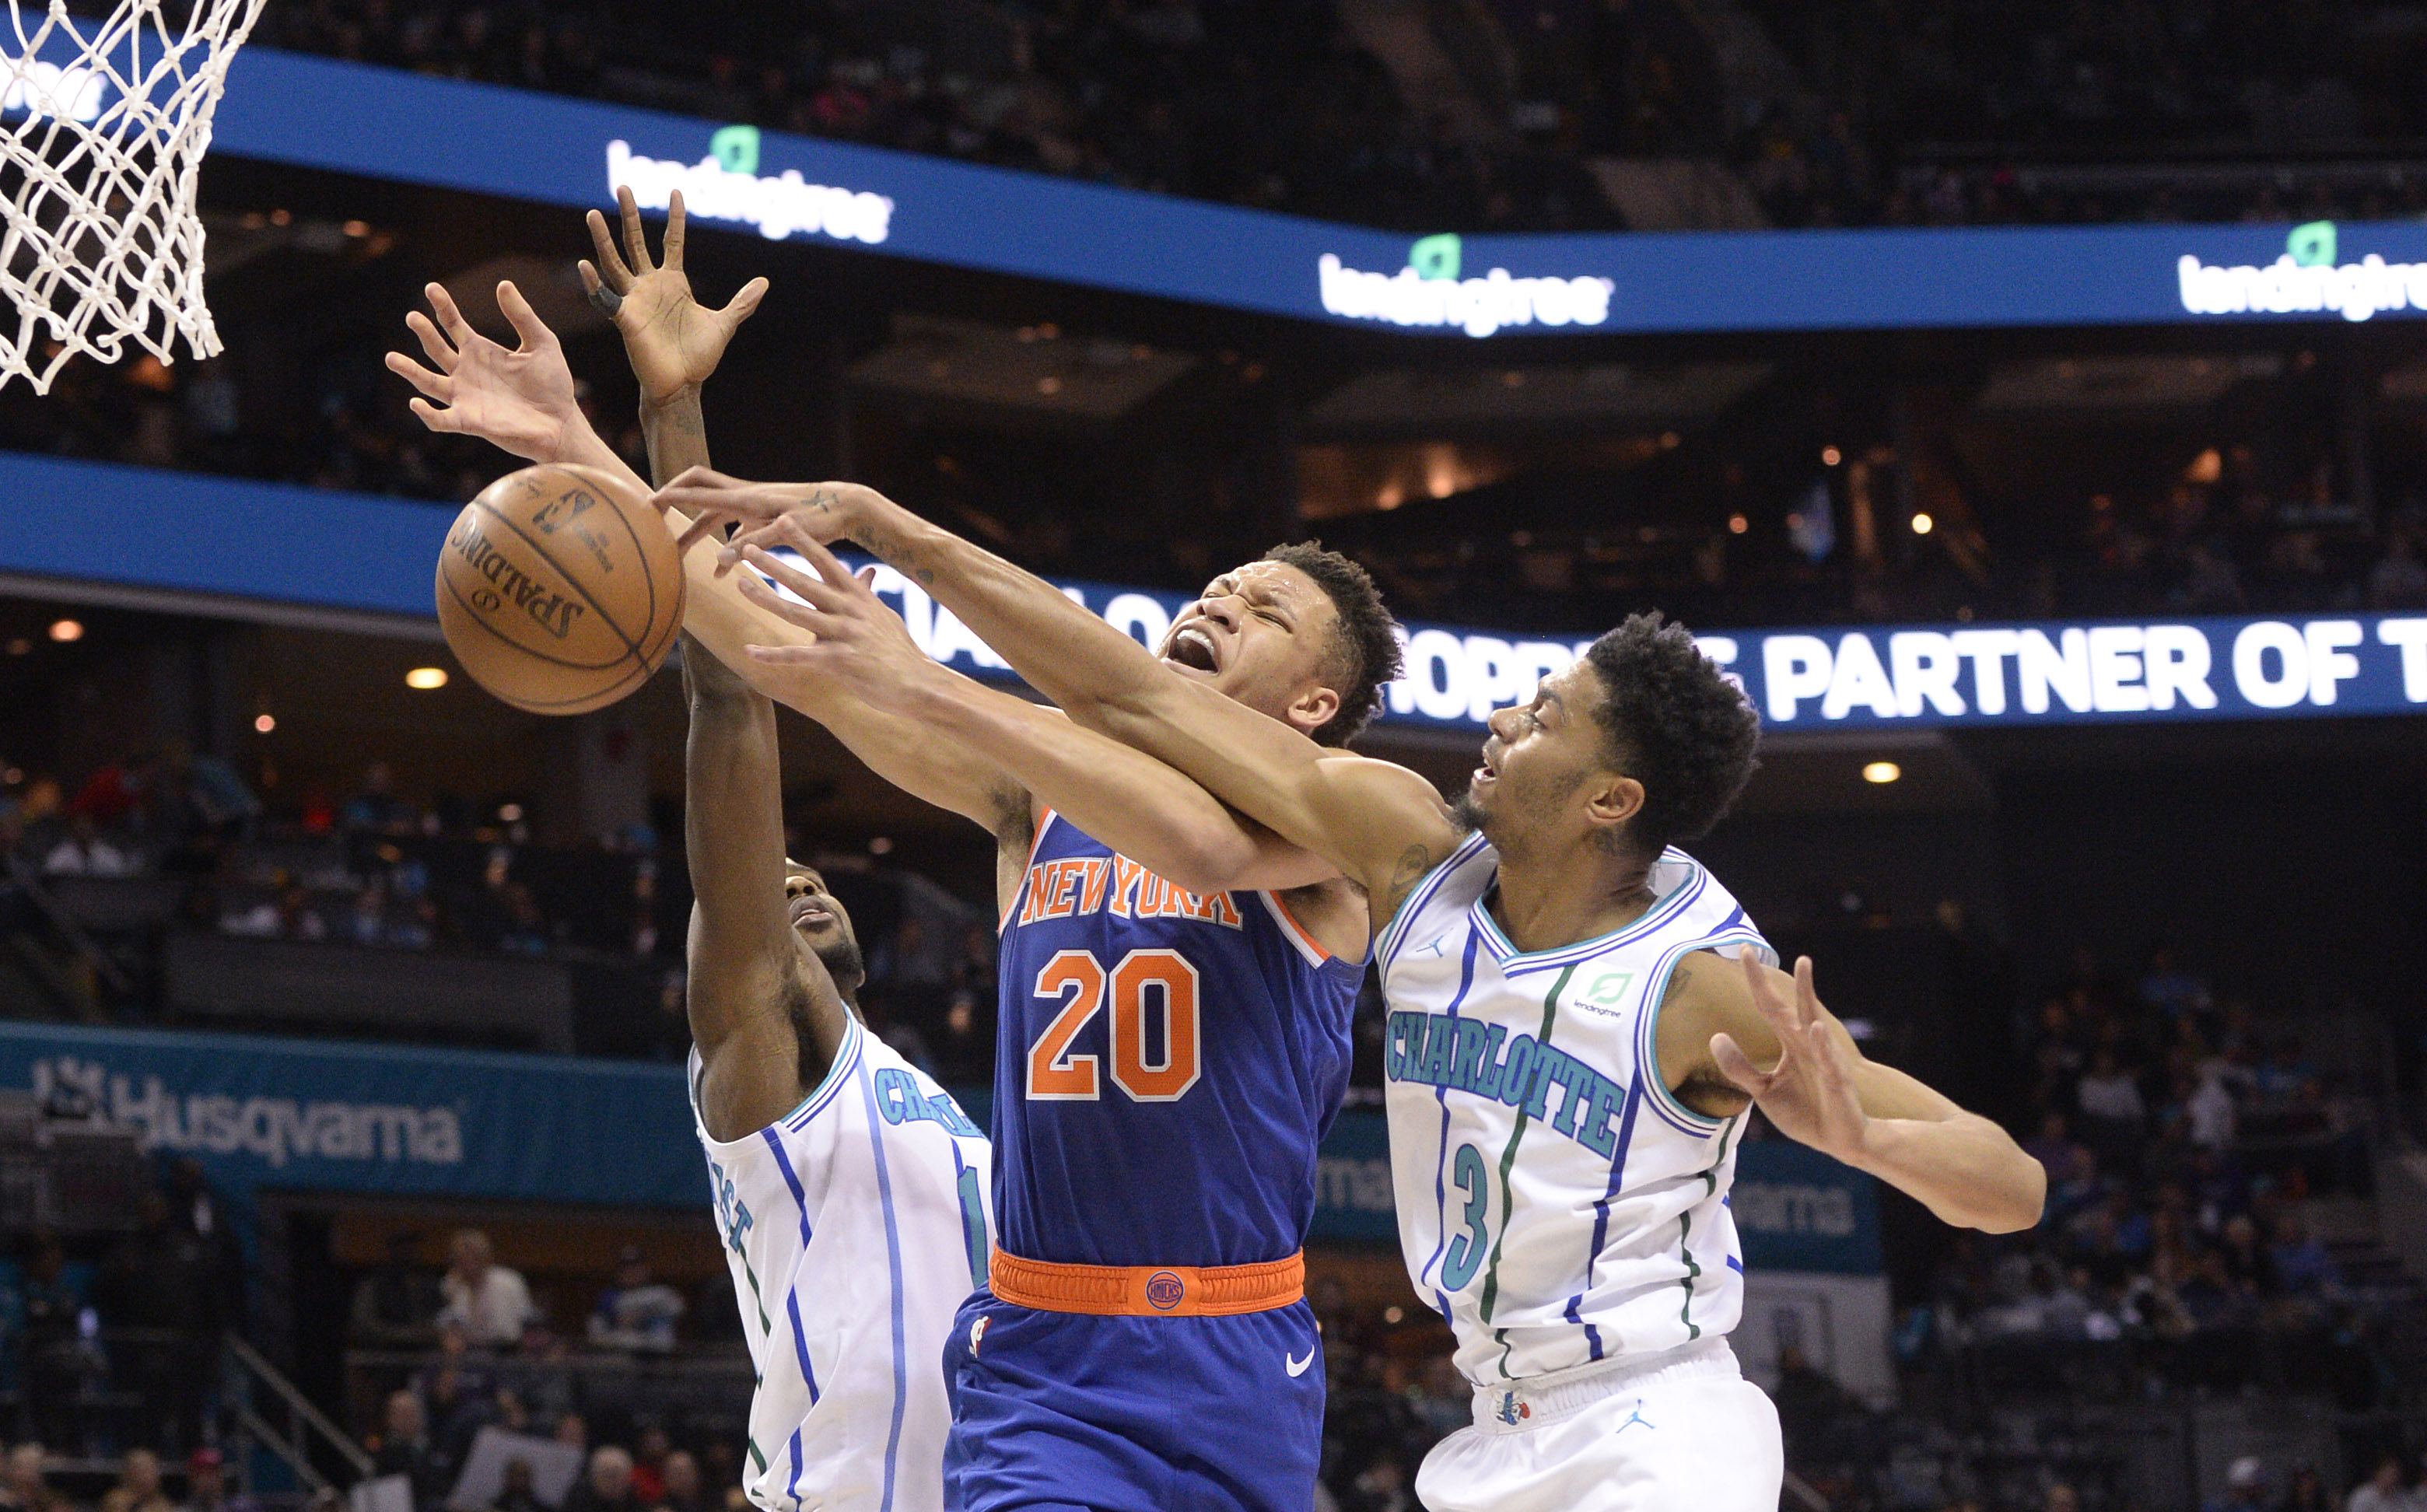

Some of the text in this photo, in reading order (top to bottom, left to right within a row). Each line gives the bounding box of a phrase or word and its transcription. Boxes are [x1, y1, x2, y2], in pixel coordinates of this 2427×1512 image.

[452, 510, 585, 640] SPALDING
[1762, 625, 2218, 722] PARTNER
[2232, 620, 2363, 709] OF
[1018, 857, 1112, 928] NEW
[1025, 948, 1201, 1103] 20
[1574, 999, 1621, 1018] lendingtree
[110, 1073, 463, 1167] Husqvarna
[1386, 1010, 1627, 1161] CHARLOTTE
[1441, 1143, 1488, 1292] 3
